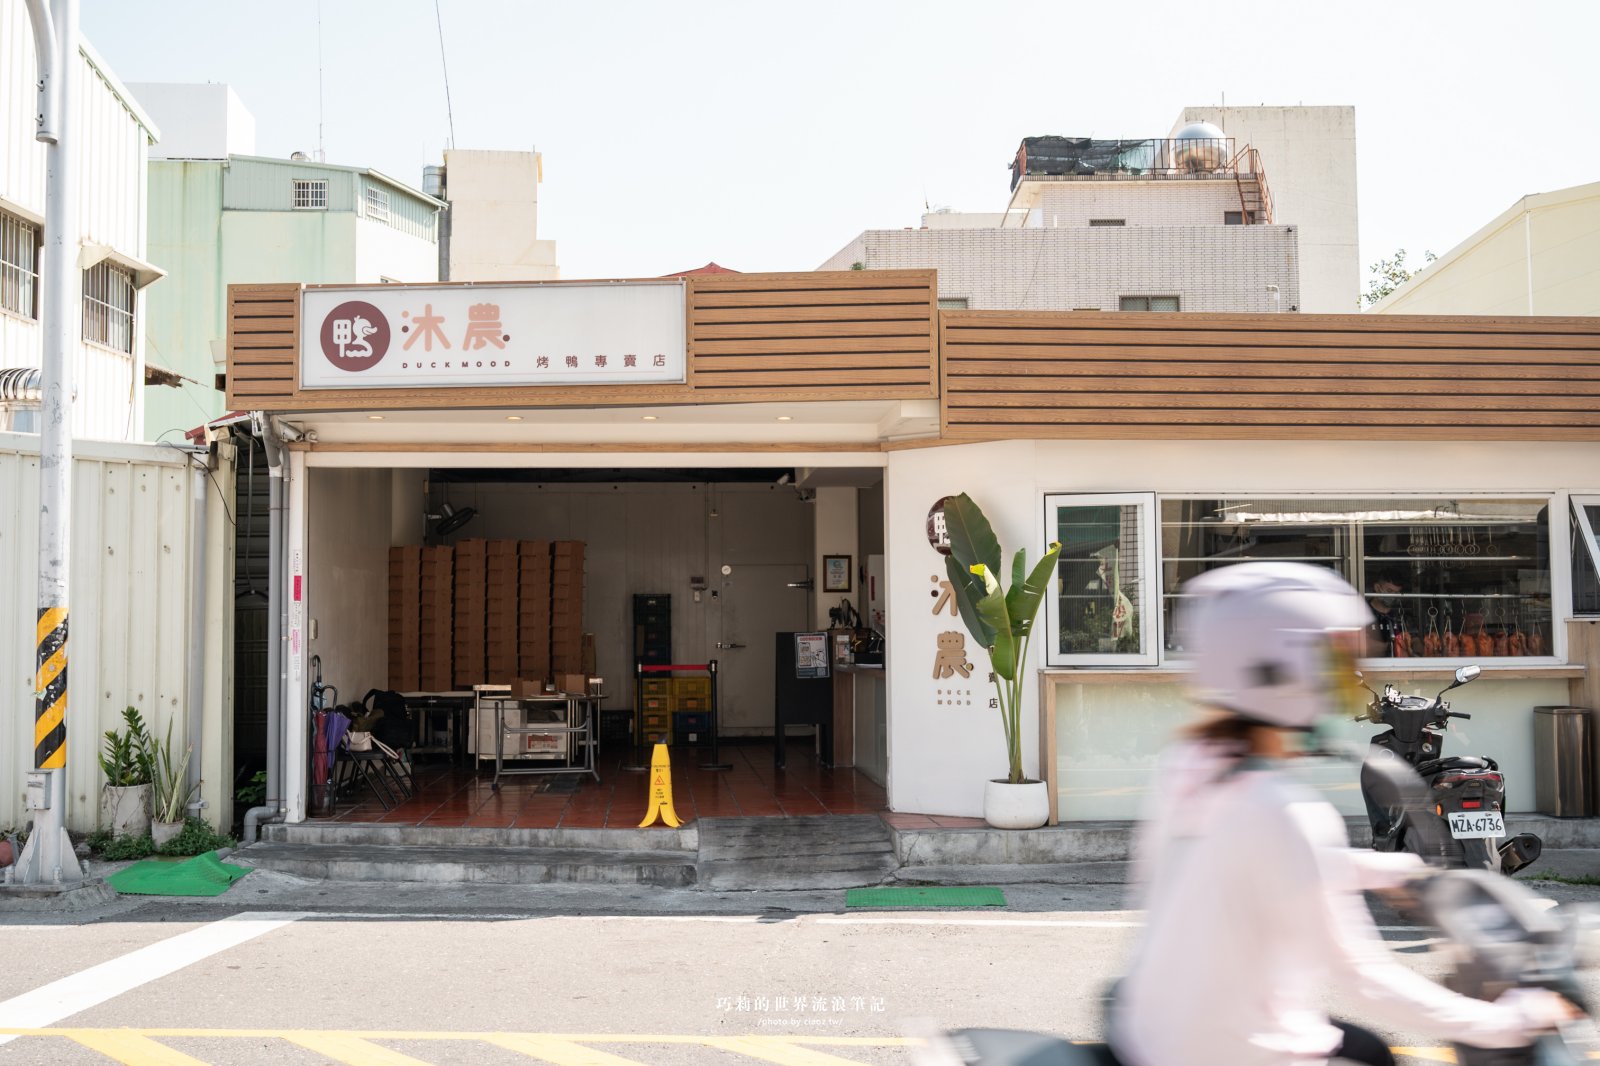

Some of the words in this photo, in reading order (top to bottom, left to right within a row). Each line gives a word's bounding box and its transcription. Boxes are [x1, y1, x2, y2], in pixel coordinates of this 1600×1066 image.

[401, 302, 510, 352] 沐農
[402, 361, 451, 369] DUCK
[461, 360, 511, 368] MOOD
[536, 354, 666, 369] 烤鴨專賣店
